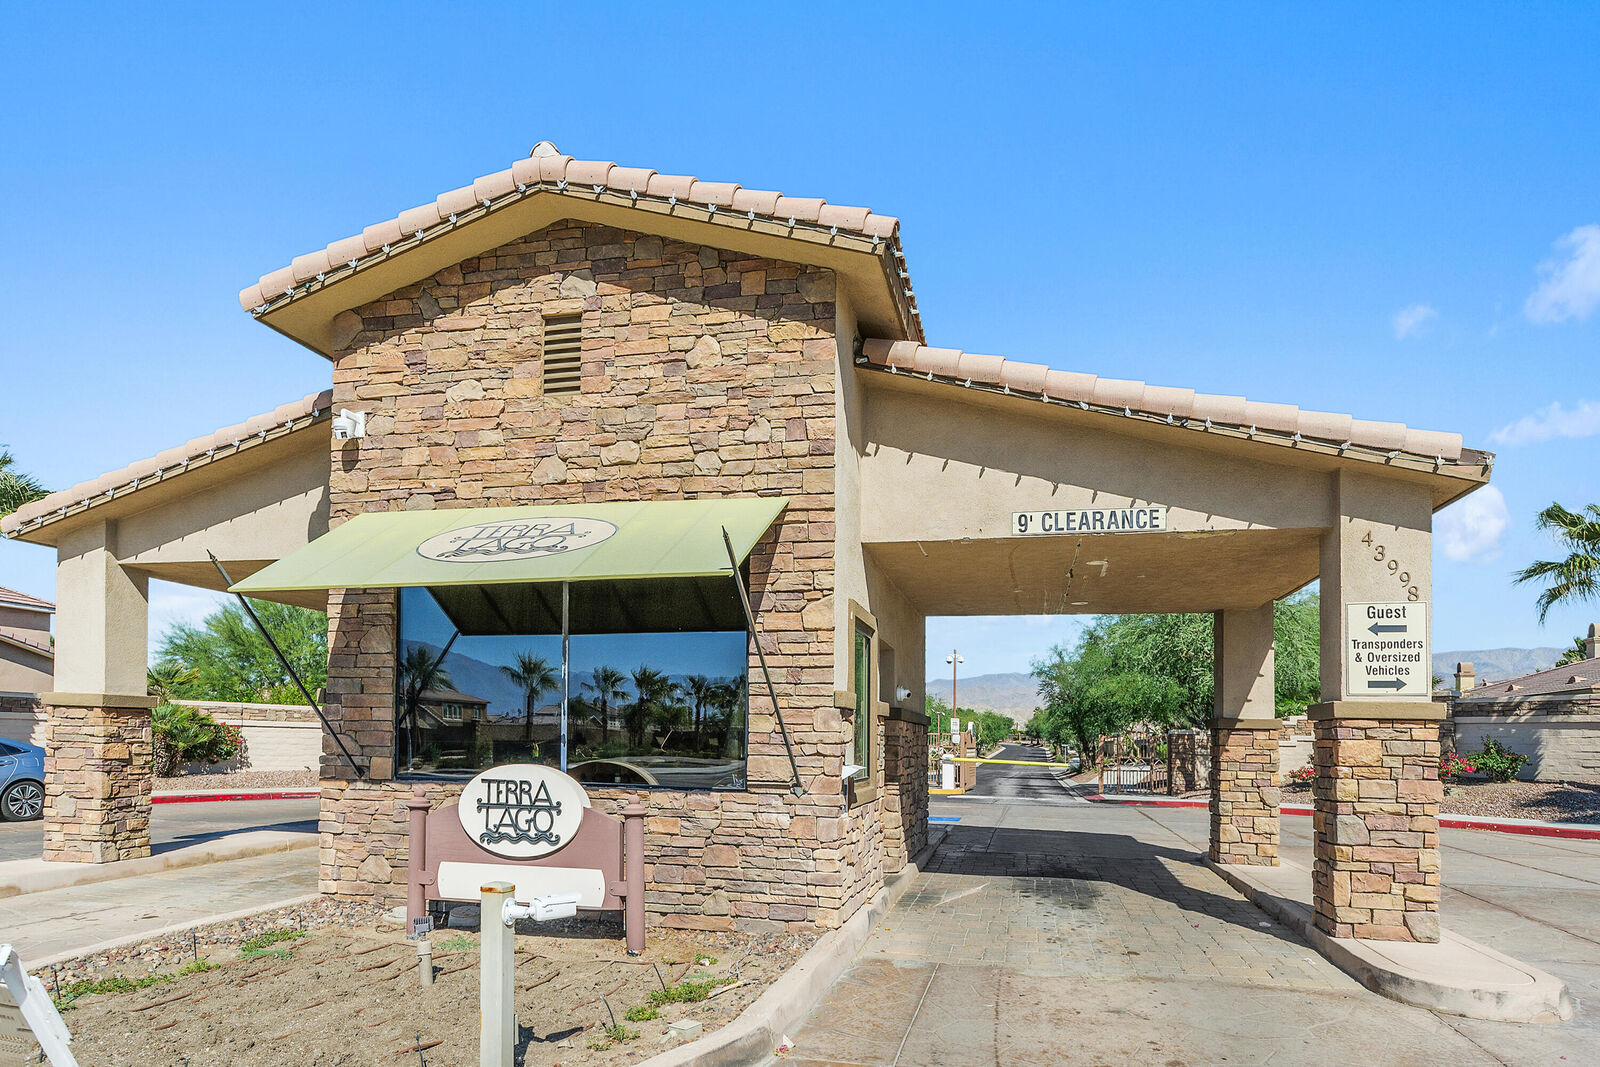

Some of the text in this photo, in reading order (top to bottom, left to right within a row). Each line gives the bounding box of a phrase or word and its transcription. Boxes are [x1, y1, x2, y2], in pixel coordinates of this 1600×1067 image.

[1041, 509, 1160, 532] CLEARANCE
[474, 521, 576, 540] TERRA
[455, 535, 567, 552] LAGO
[1361, 530, 1419, 602] 43998
[1366, 605, 1407, 619] Guest
[1351, 638, 1424, 651] Transponders
[1354, 651, 1421, 663] & Oversized
[1365, 665, 1410, 676] Vehicles
[480, 778, 554, 806] TERRA
[485, 805, 555, 835] LAGO
